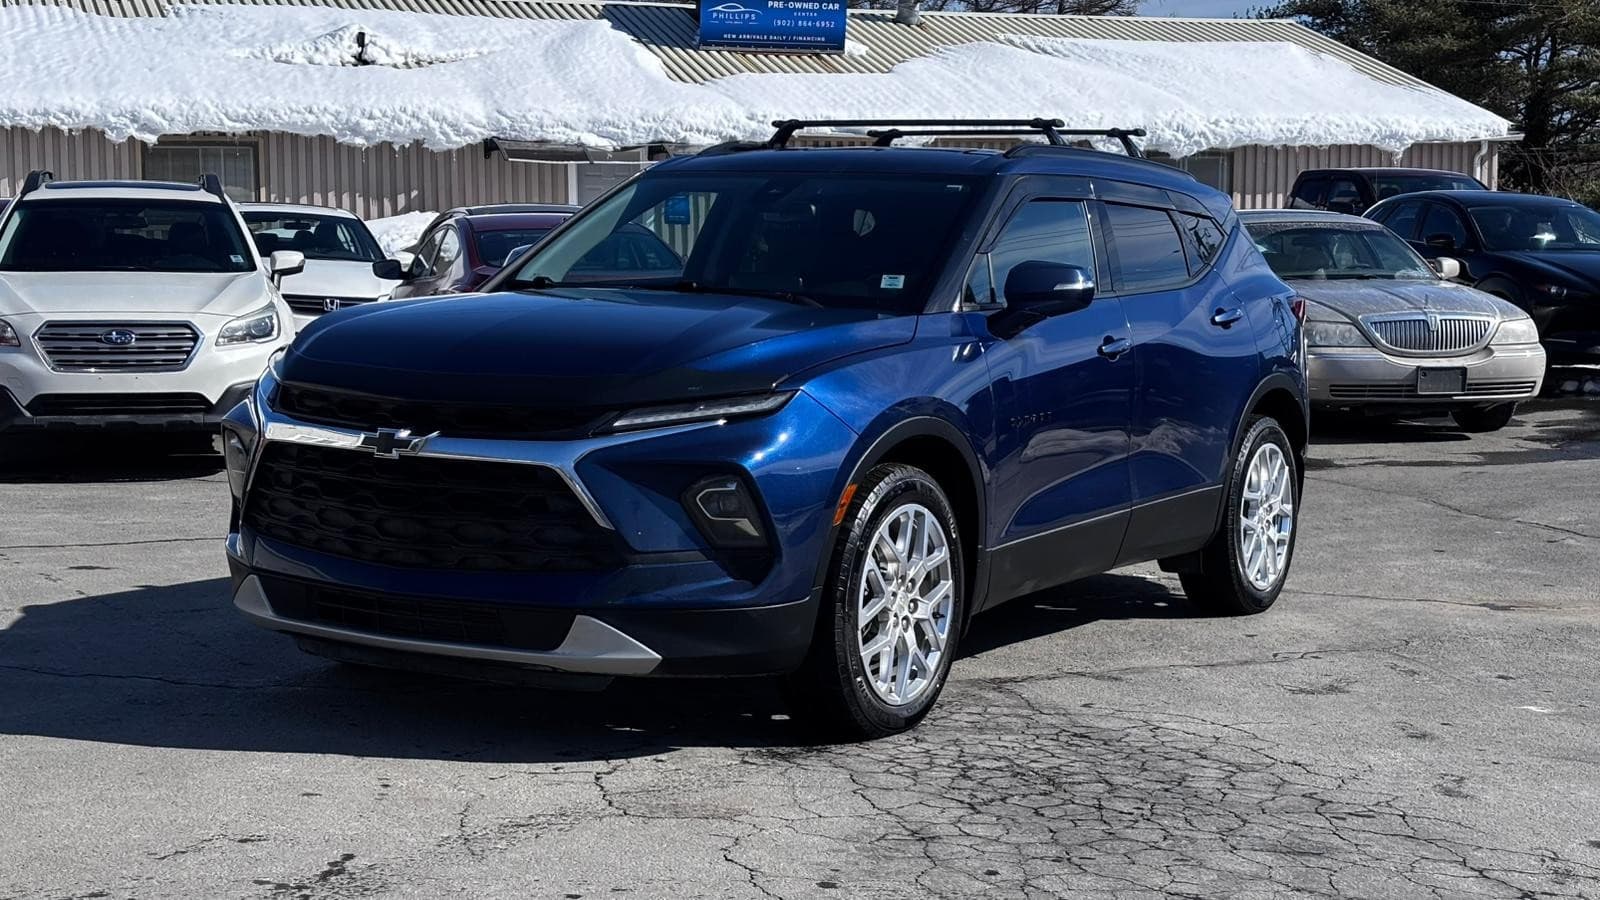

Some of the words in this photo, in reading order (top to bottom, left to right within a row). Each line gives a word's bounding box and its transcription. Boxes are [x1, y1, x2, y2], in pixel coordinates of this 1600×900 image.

[767, 1, 820, 10] PRE-OWNED
[821, 2, 840, 10] CAR
[712, 12, 756, 20] PHILLIPS
[773, 19, 795, 27] (902)
